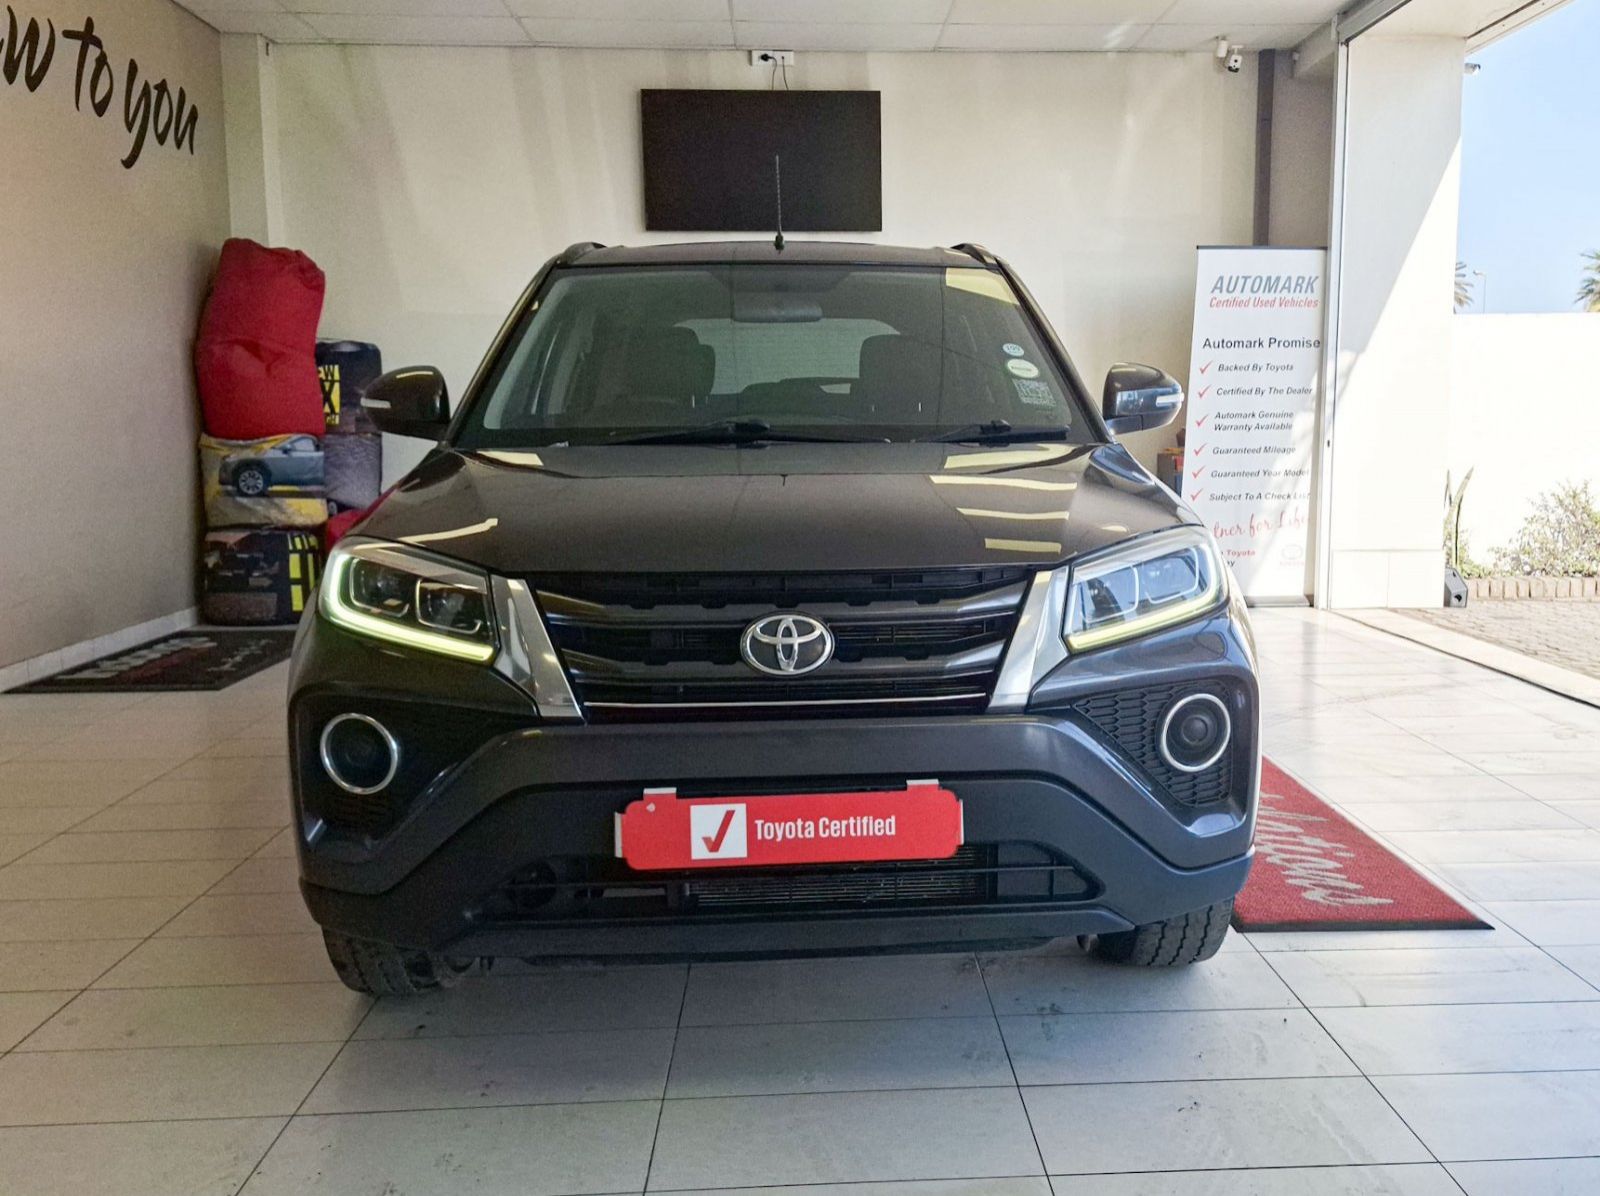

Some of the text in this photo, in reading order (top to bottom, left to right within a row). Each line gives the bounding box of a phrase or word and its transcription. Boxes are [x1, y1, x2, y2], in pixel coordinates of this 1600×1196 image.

[0, 5, 199, 170] w to you
[1210, 275, 1319, 294] AUTOMARK
[1209, 296, 1319, 308] Certified Used Vehicles
[1202, 337, 1321, 349] Automark Promise
[1217, 362, 1294, 373] Backed By Toyota
[1216, 386, 1312, 397] Certified By The Dealer
[1214, 410, 1294, 420] Automark Genuine
[1213, 422, 1293, 432] Warranty Available
[1212, 445, 1296, 455] Guaranteed Mileage
[1210, 469, 1260, 478] Guaranteed
[1262, 468, 1281, 477] Year
[1209, 492, 1242, 502] Subject
[1245, 492, 1255, 500] To
[1256, 492, 1262, 500] A
[1264, 491, 1291, 500] Check
[1226, 549, 1256, 558] Toyota
[755, 815, 896, 842] Toyota Certified
